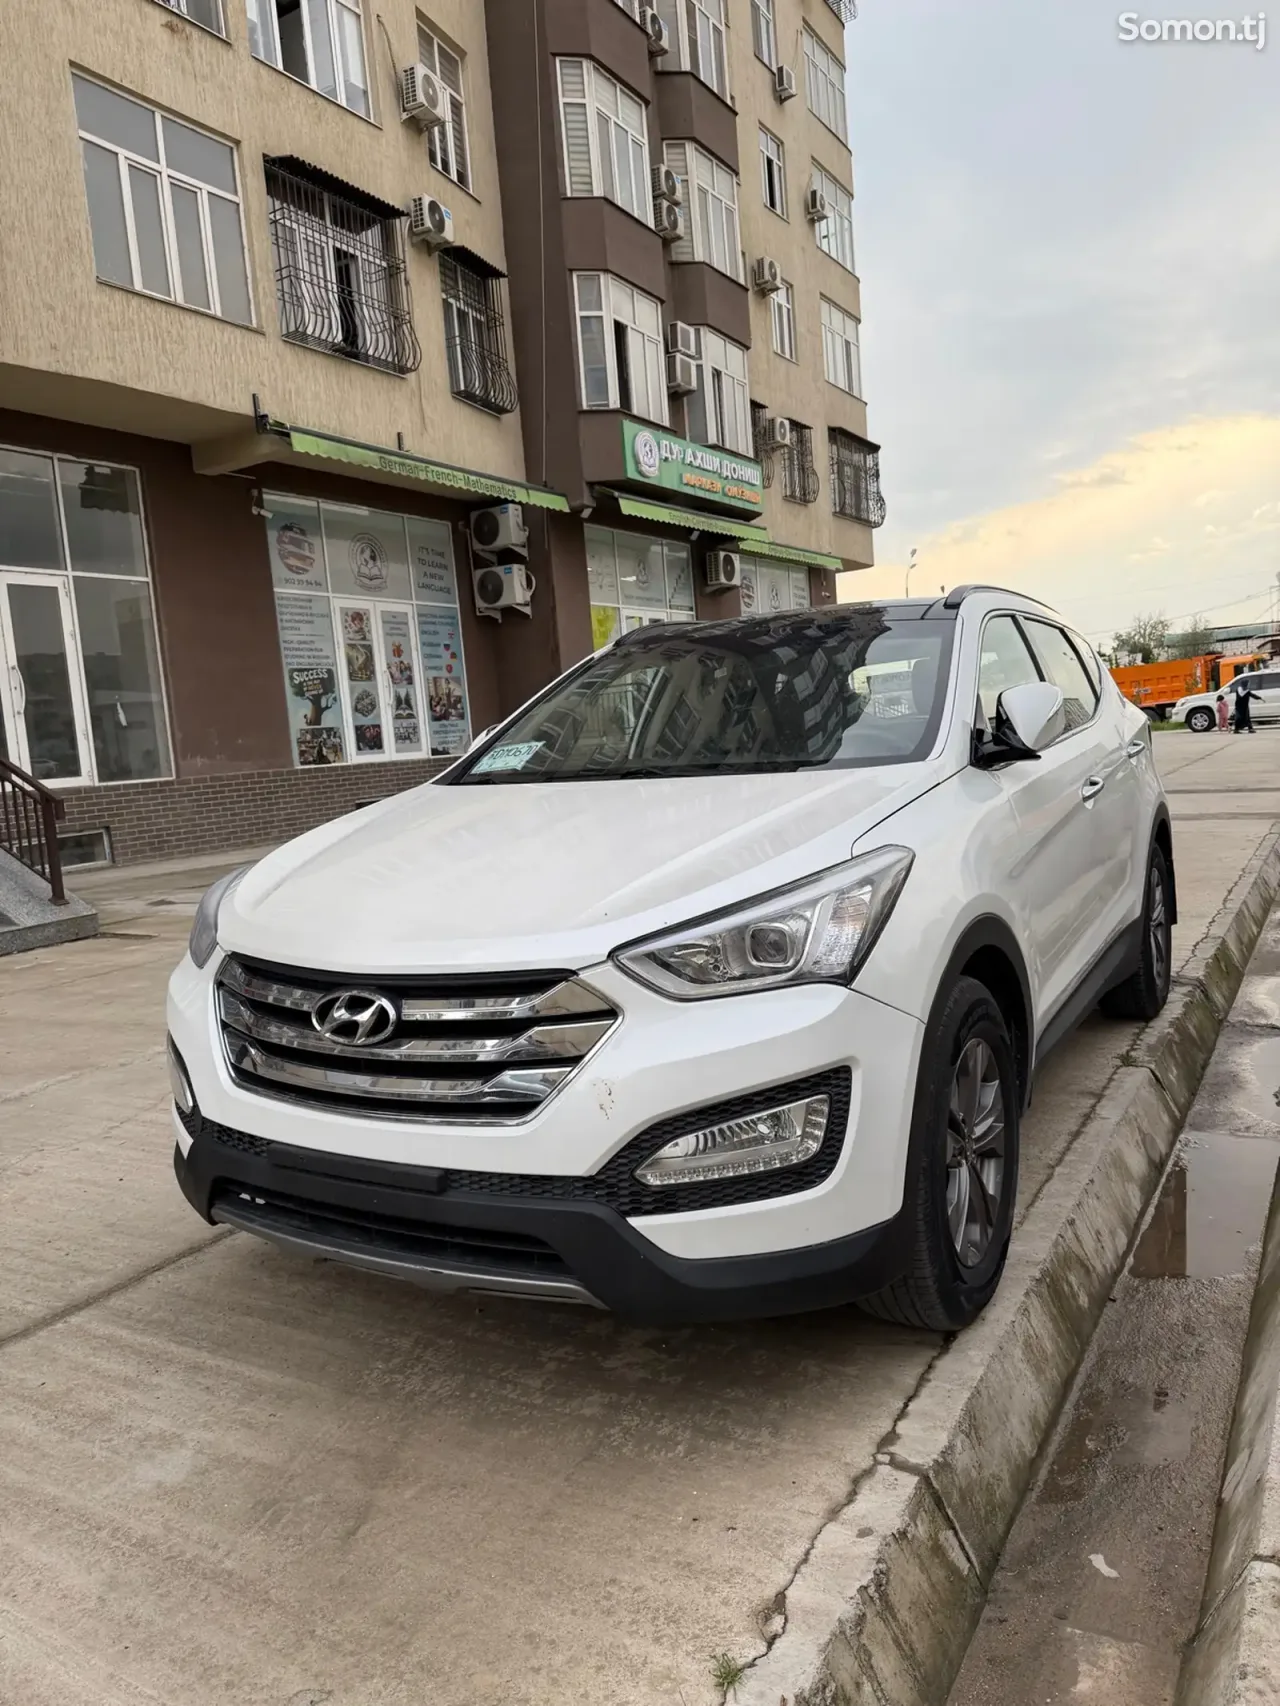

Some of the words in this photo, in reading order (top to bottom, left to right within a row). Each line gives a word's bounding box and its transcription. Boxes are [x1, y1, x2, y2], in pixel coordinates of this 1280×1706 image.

[721, 460, 760, 485] ДОНИШ
[417, 557, 427, 566] TO
[427, 560, 449, 572] LEARN
[429, 572, 445, 581] NEW
[417, 582, 452, 595] LANGUAGE
[292, 668, 328, 684] SUCCESS
